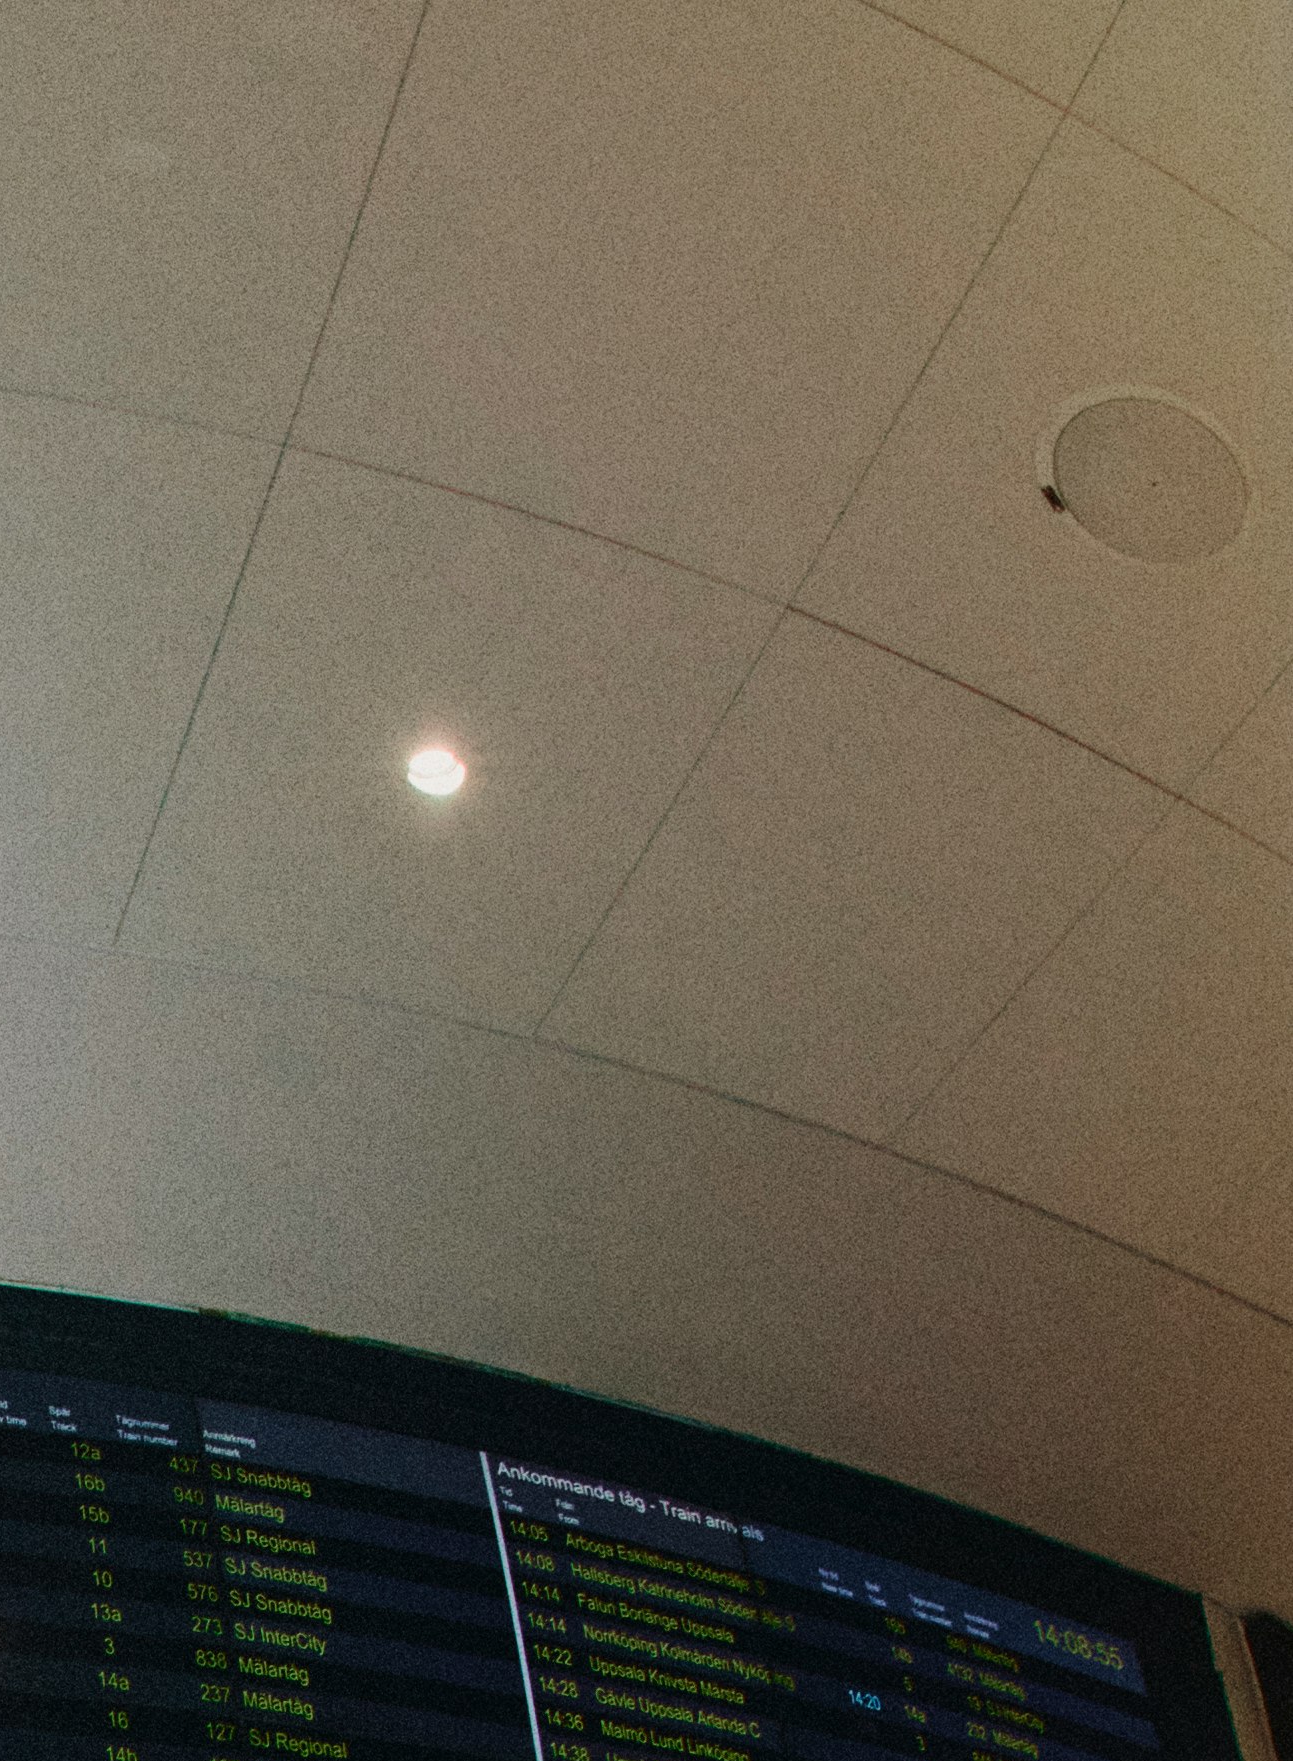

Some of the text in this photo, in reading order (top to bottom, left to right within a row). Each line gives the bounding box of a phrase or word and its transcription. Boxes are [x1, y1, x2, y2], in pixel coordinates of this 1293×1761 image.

[210, 1463, 312, 1498] SJ Snabbtåg
[498, 1462, 615, 1502] Ankommande
[618, 1491, 646, 1513] tåg
[660, 1500, 701, 1523] Train
[215, 1495, 284, 1523] Mälartåg
[220, 1525, 316, 1555] SJ Regional
[225, 1557, 327, 1592] SJ Snabbtåg
[522, 1581, 560, 1601] 14:14
[229, 1589, 332, 1625] SJ Snabbtåg
[528, 1613, 566, 1633] 14:14
[234, 1623, 326, 1656] SJ InterCity
[1034, 1621, 1123, 1670] 14:08:55
[533, 1644, 572, 1666] 14:22
[238, 1657, 309, 1686] Mälartåg
[539, 1677, 578, 1698] 14:28
[243, 1690, 314, 1721] Mälartåg
[545, 1709, 584, 1731] 14:36
[249, 1728, 347, 1758] SJ Regional
